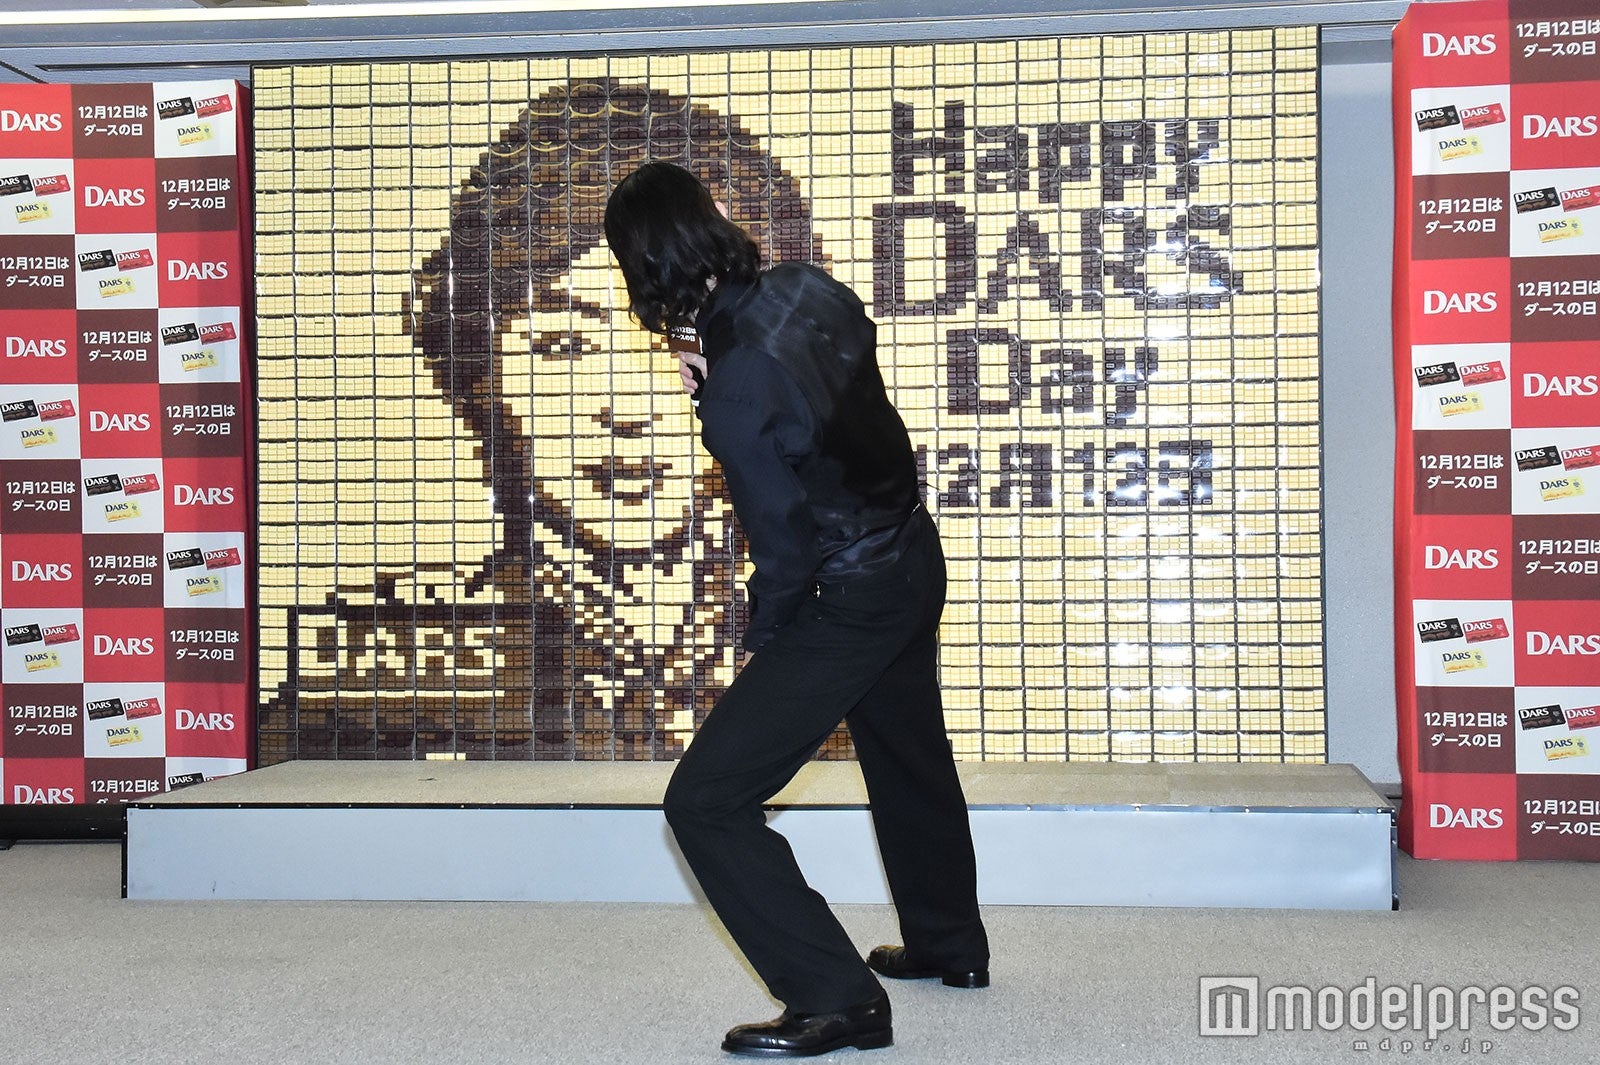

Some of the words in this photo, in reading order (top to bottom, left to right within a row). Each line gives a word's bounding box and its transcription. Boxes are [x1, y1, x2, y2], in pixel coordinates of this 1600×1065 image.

[1516, 20, 1600, 37] 12月12日は
[1422, 33, 1497, 57] DARS
[1524, 41, 1596, 57] ダースの日
[158, 100, 182, 111] DARS
[195, 98, 220, 109] DARS
[78, 105, 148, 119] 12月12日は
[1416, 109, 1444, 121] DARS
[1460, 107, 1490, 119] DARS
[1, 110, 62, 132] DARS
[1523, 115, 1598, 139] DARS
[84, 124, 142, 136] ダースの日
[178, 125, 201, 137] DARS
[1439, 138, 1467, 150] DARS
[893, 100, 1219, 204] Happy
[33, 176, 57, 187] DARS
[162, 179, 230, 192] 12月12日は
[84, 186, 146, 206] DARS
[1515, 191, 1544, 203] DARS
[1561, 189, 1590, 201] DARS
[16, 203, 39, 214] DARS
[168, 197, 226, 210] ダースの日
[1419, 198, 1502, 214] 12月12日は
[1425, 219, 1496, 234] ダースの日
[1538, 220, 1567, 232] DARS
[0, 257, 69, 269] 12月12日は
[78, 252, 103, 262] DARS
[116, 252, 140, 262] DARS
[872, 200, 1243, 318] DARS
[168, 260, 228, 280] DARS
[6, 275, 64, 287] ダースの日
[100, 278, 122, 288] DARS
[1423, 291, 1497, 314] DARS
[1524, 302, 1596, 316] ダースの日
[162, 325, 186, 336] DARS
[200, 325, 223, 335] DARS
[83, 331, 152, 344] 12月12日は
[6, 337, 66, 357] DARS
[89, 350, 147, 361] ダースの日
[182, 351, 205, 362] DARS
[1416, 365, 1444, 377] DARS
[1460, 364, 1490, 376] DARS
[946, 327, 1158, 426] Day
[1523, 373, 1598, 397] DARS
[1439, 395, 1468, 406] DARS
[1, 402, 25, 412] DARS
[39, 402, 62, 412] DARS
[167, 405, 235, 418] 12月12日は
[90, 410, 151, 432] DARS
[22, 429, 44, 439] DARS
[173, 423, 230, 434] ダースの日
[1516, 449, 1546, 461] DARS
[1563, 448, 1592, 460] DARS
[1420, 454, 1504, 470] 12月12日は
[85, 476, 109, 487] DARS
[123, 476, 146, 486] DARS
[1427, 475, 1498, 489] ダースの日
[1540, 479, 1569, 490] DARS
[6, 481, 75, 494] 12月12日は
[174, 484, 234, 505] DARS
[12, 499, 70, 512] ダースの日
[105, 503, 128, 513] DARS
[168, 550, 192, 561] DARS
[205, 550, 229, 561] DARS
[1425, 545, 1499, 569] DARS
[89, 556, 157, 569] 12月12日は
[1526, 560, 1598, 574] ダースの日
[12, 560, 72, 582] DARS
[94, 574, 152, 586] ダースの日
[187, 577, 210, 587] DARS
[5, 626, 30, 636] DARS
[43, 626, 67, 636] DARS
[1418, 621, 1447, 632] DARS
[1464, 621, 1493, 632] DARS
[170, 630, 239, 644] 12月12日は
[1526, 631, 1600, 655] DARS
[93, 635, 154, 656] DARS
[299, 614, 505, 676] DARS
[25, 652, 49, 663] DARS
[176, 648, 234, 660] ダースの日
[1443, 652, 1471, 662] DARS
[87, 700, 111, 711] DARS
[125, 700, 148, 711] DARS
[9, 706, 77, 719] 12月12日は
[1520, 707, 1549, 718] DARS
[1566, 708, 1596, 719] DARS
[176, 709, 234, 730] DARS
[1424, 712, 1507, 727] 12月12日は
[14, 724, 72, 736] ダースの日
[107, 727, 130, 737] DARS
[1431, 733, 1501, 747] ダースの日
[1544, 739, 1573, 750] DARS
[169, 775, 193, 785] DARS
[91, 780, 159, 793] 12月12日は
[14, 785, 74, 804] DARS
[1430, 804, 1503, 828] DARS
